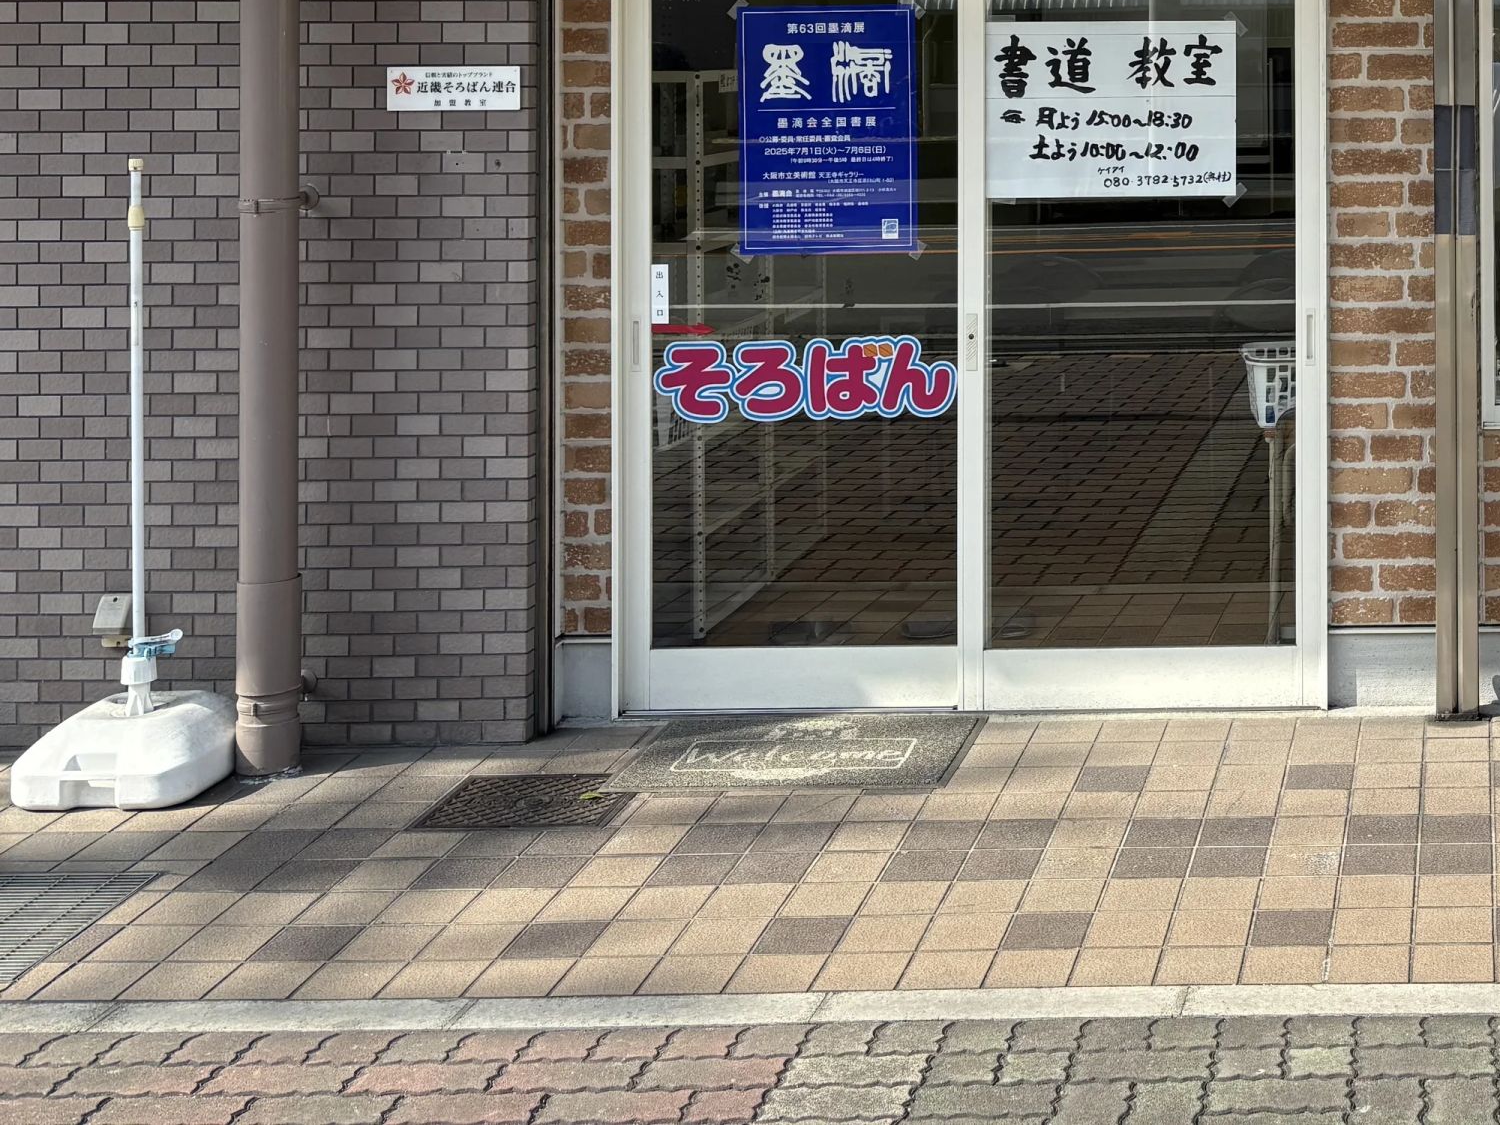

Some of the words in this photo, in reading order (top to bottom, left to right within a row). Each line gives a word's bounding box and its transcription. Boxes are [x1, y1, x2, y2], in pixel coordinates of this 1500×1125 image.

[787, 21, 866, 35] 第63回墨滴展
[994, 34, 1096, 99] 書道
[1127, 33, 1223, 90] 教室
[417, 80, 517, 94] 近畿そろばん連合
[777, 116, 877, 129] 墨滴会全国書展
[763, 171, 816, 180] 大阪市立美術館
[655, 270, 664, 317] 出入口
[659, 341, 953, 419] そろばん
[684, 744, 905, 768] Welcome
